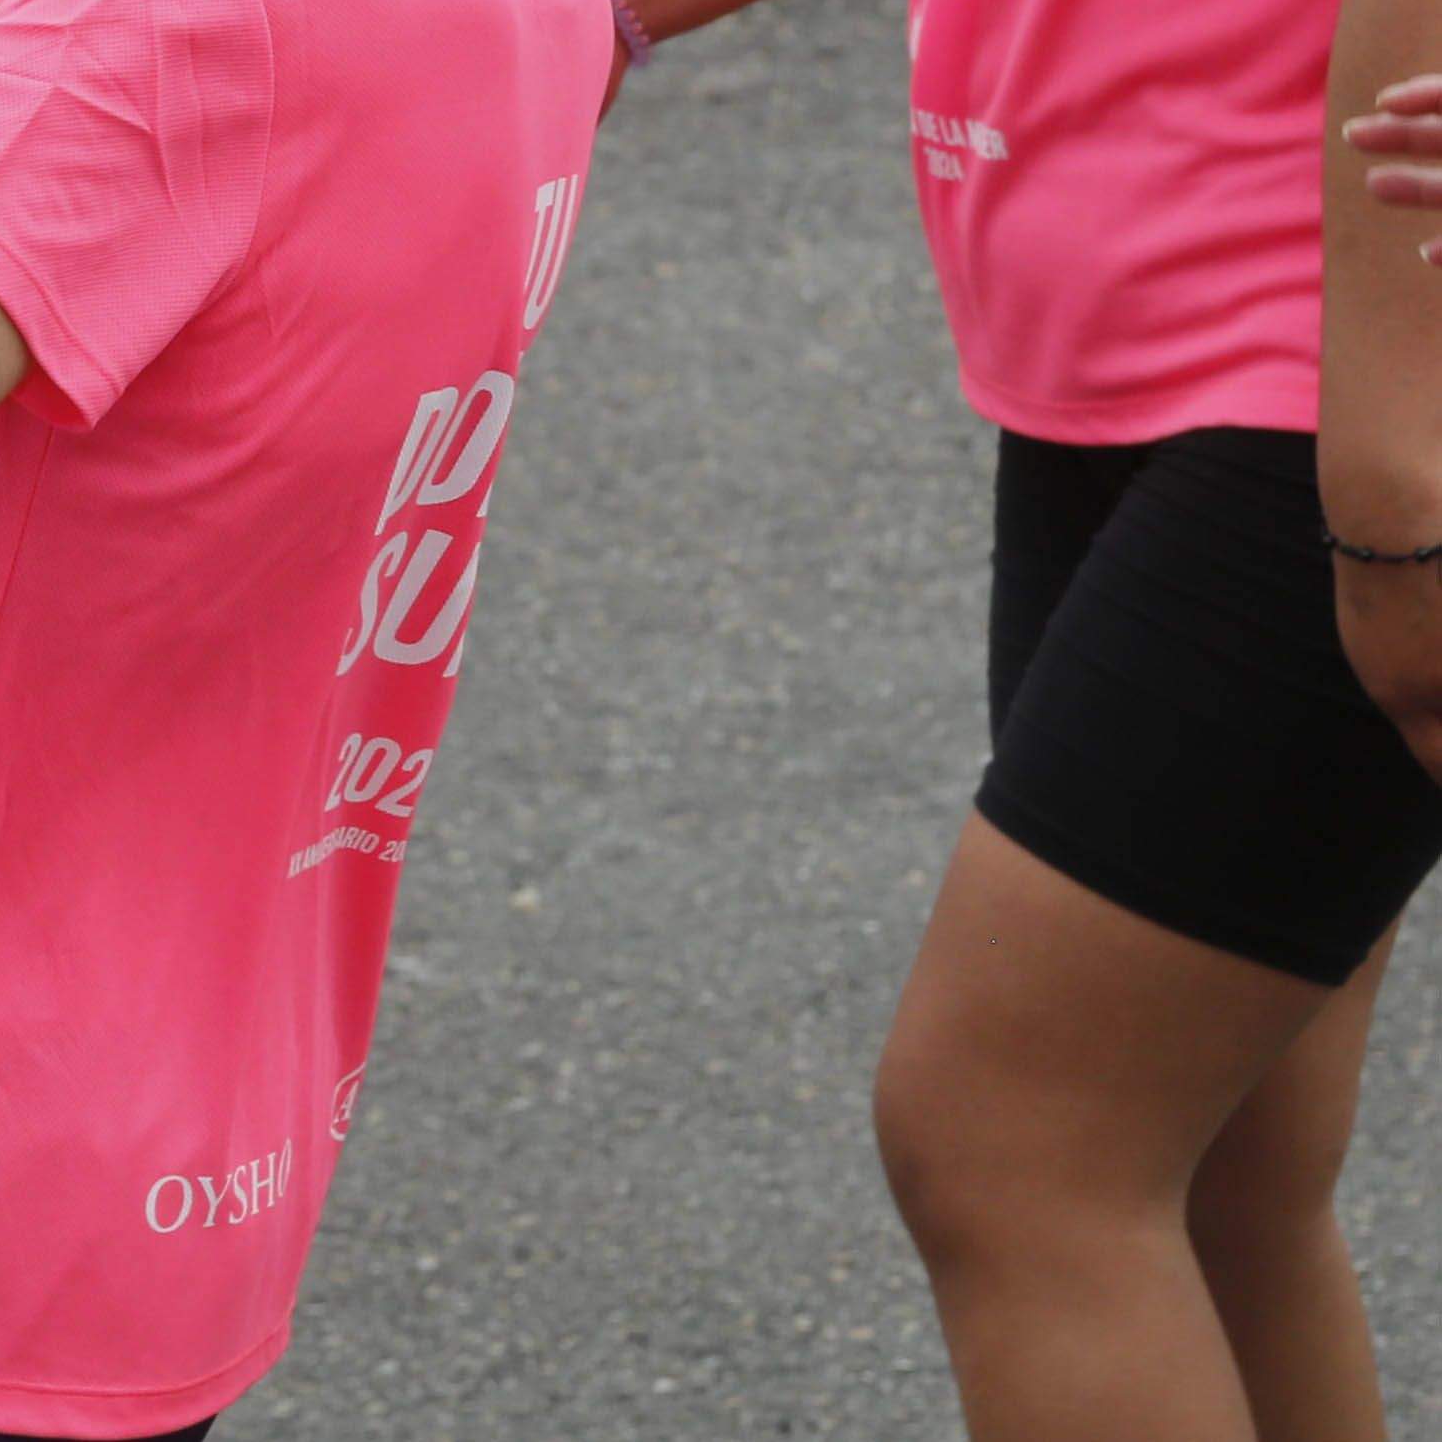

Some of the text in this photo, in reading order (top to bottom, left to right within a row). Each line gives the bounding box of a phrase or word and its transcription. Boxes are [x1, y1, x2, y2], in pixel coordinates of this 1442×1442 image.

[373, 352, 523, 537] DO
[334, 529, 481, 679] SU
[144, 1137, 292, 1235] OYSHO
